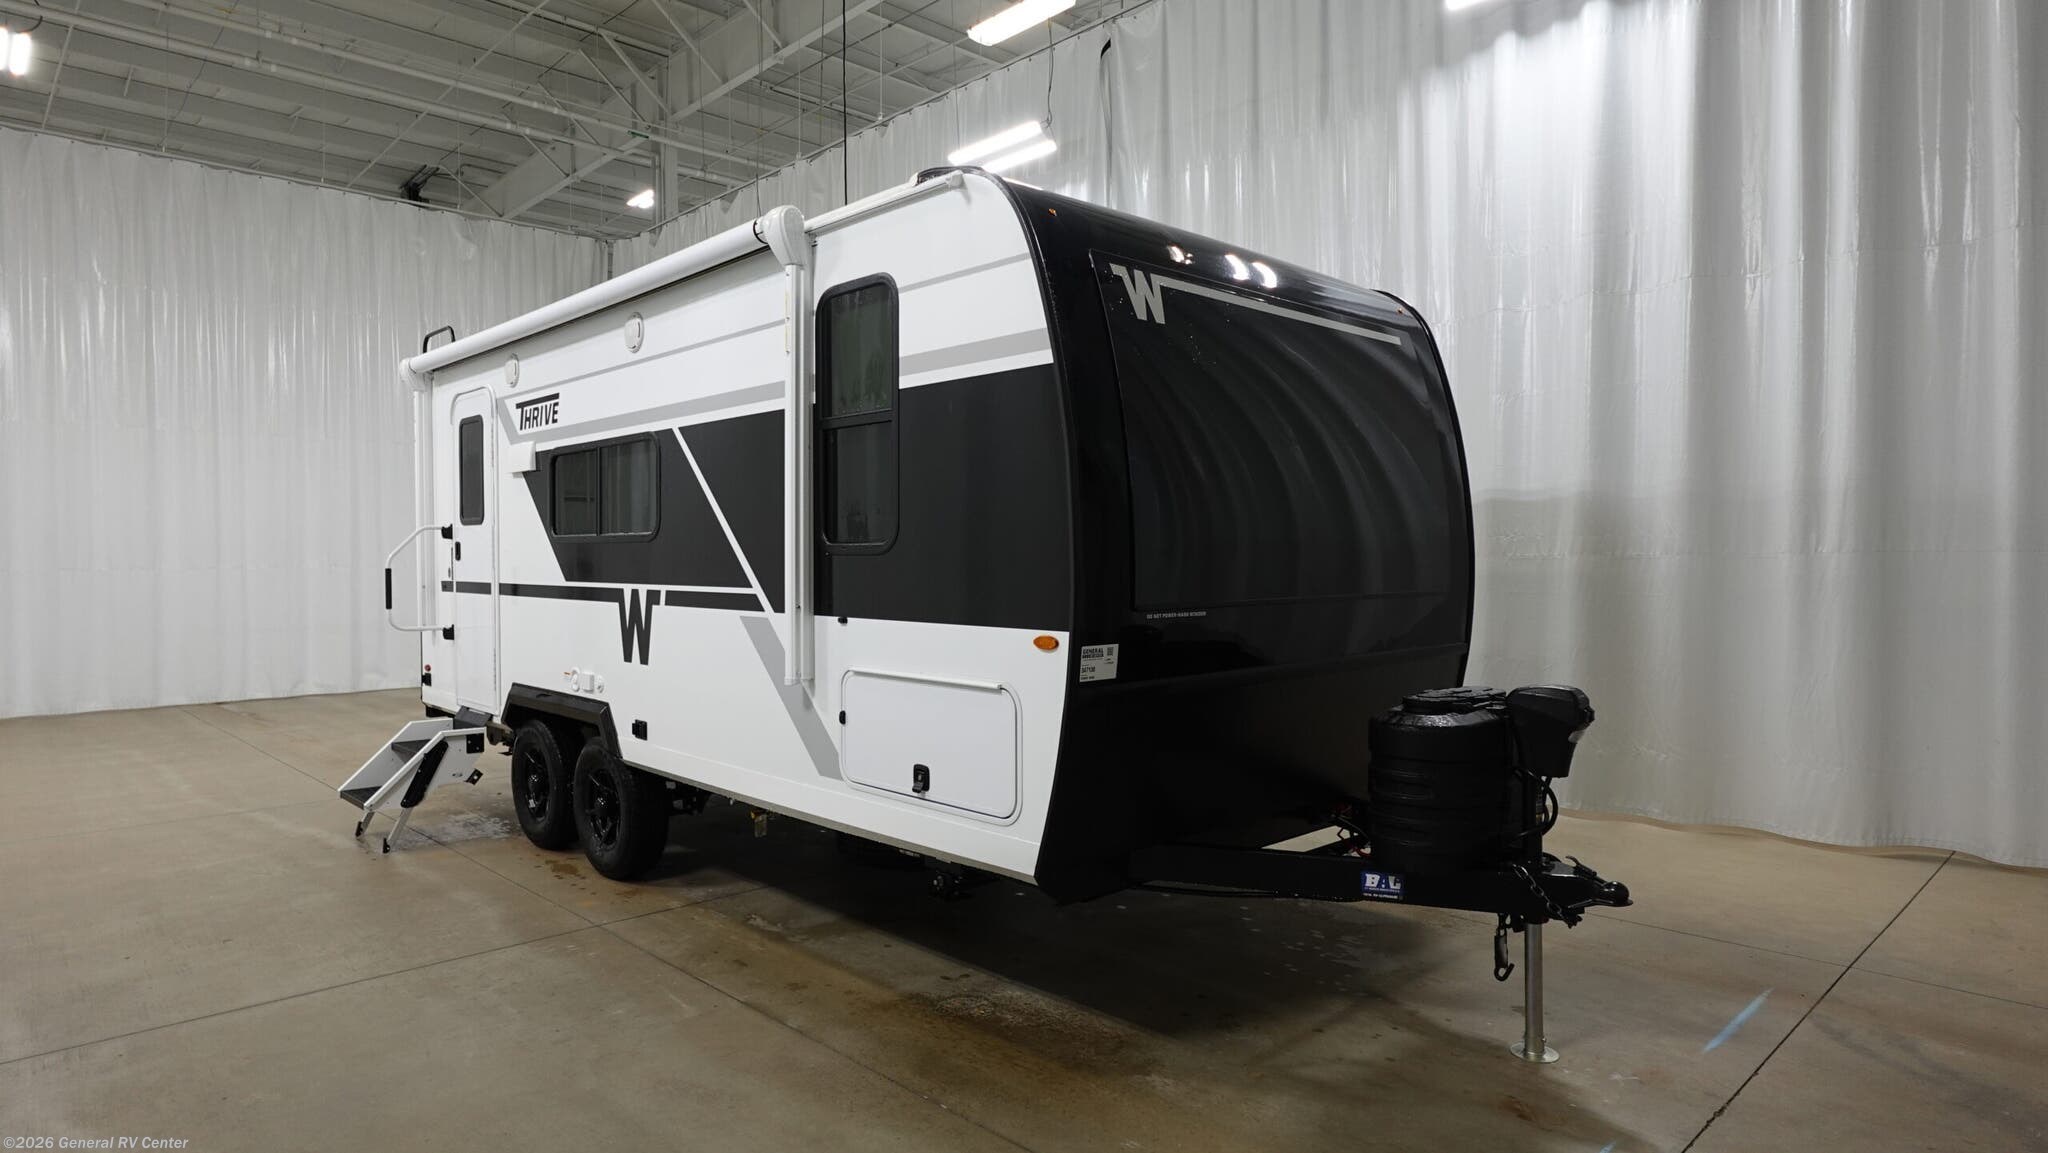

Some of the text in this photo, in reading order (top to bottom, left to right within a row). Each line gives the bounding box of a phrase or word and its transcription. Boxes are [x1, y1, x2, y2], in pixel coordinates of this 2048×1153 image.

[1109, 263, 1165, 325] W
[515, 393, 560, 431] THRIVE
[618, 588, 661, 666] W
